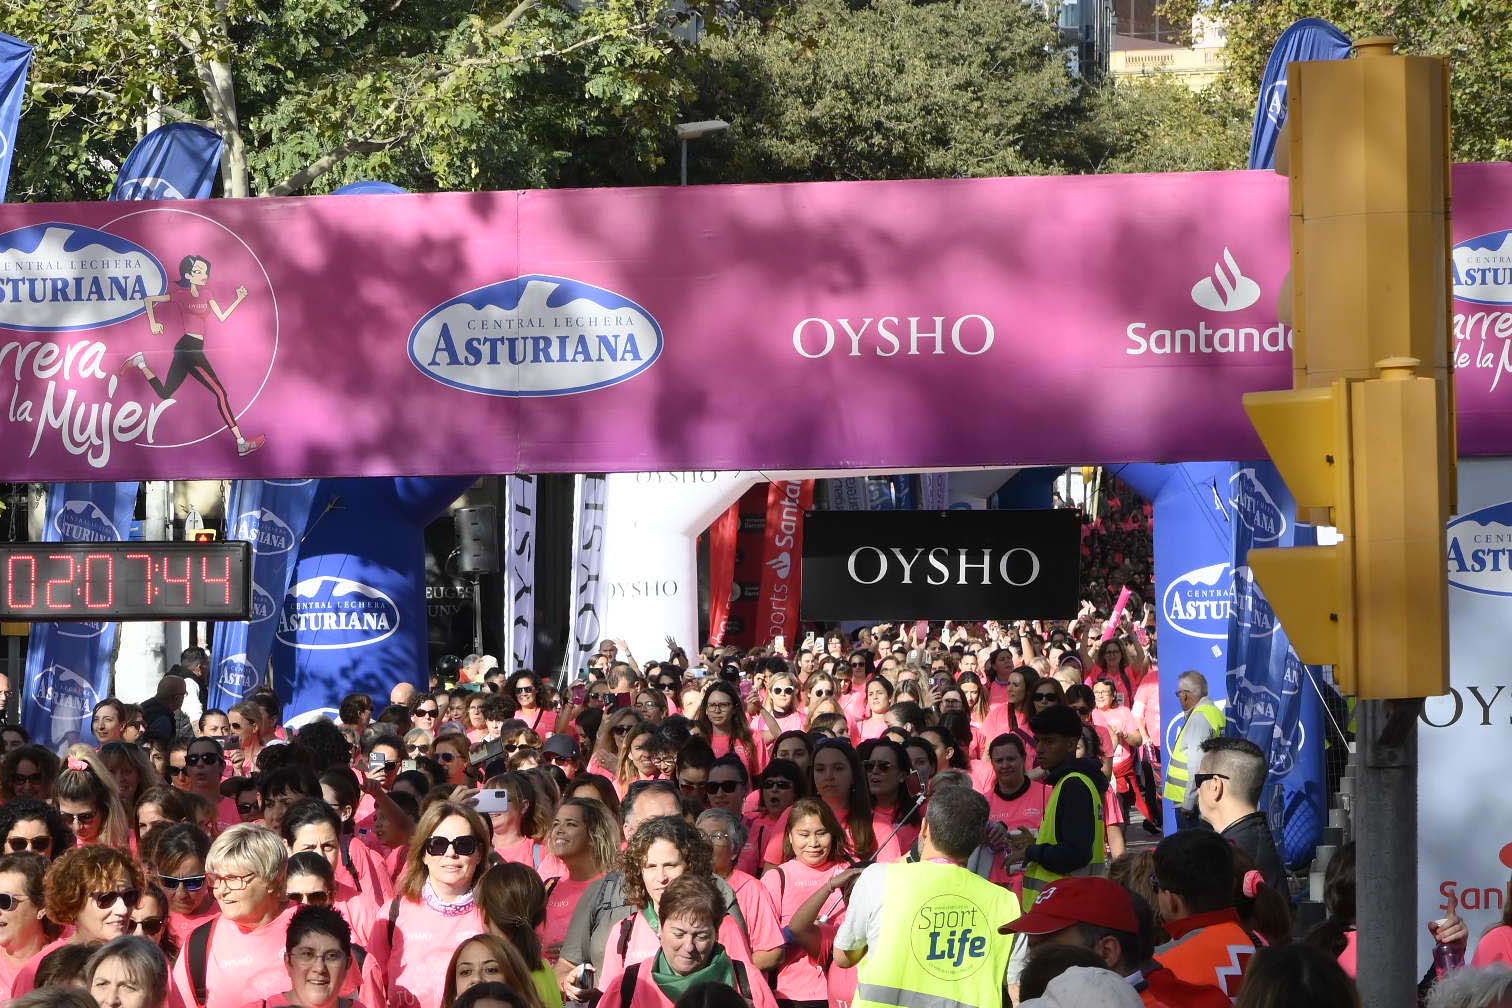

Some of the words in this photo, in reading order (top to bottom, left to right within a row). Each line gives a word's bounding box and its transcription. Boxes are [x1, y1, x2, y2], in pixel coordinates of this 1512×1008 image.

[70, 258, 142, 270] LECHERA
[466, 317, 546, 329] CENTRAL
[553, 316, 635, 328] LECHERA
[792, 314, 996, 359] OYSHO
[427, 322, 644, 367] ASTURIANA
[8, 382, 34, 423] la
[28, 374, 177, 468] Mujer
[1473, 533, 1512, 543] CENT
[7, 554, 230, 608] 02:07:44
[513, 472, 534, 670] OYSH
[575, 473, 607, 652] OYSH
[845, 545, 1042, 587] OYSHO
[277, 609, 391, 635] ASTURIANA
[290, 601, 333, 609] CENTRAL
[337, 601, 386, 609] LECHERA
[769, 584, 789, 639] ports
[918, 906, 978, 933] Sport
[926, 928, 987, 968] Life
